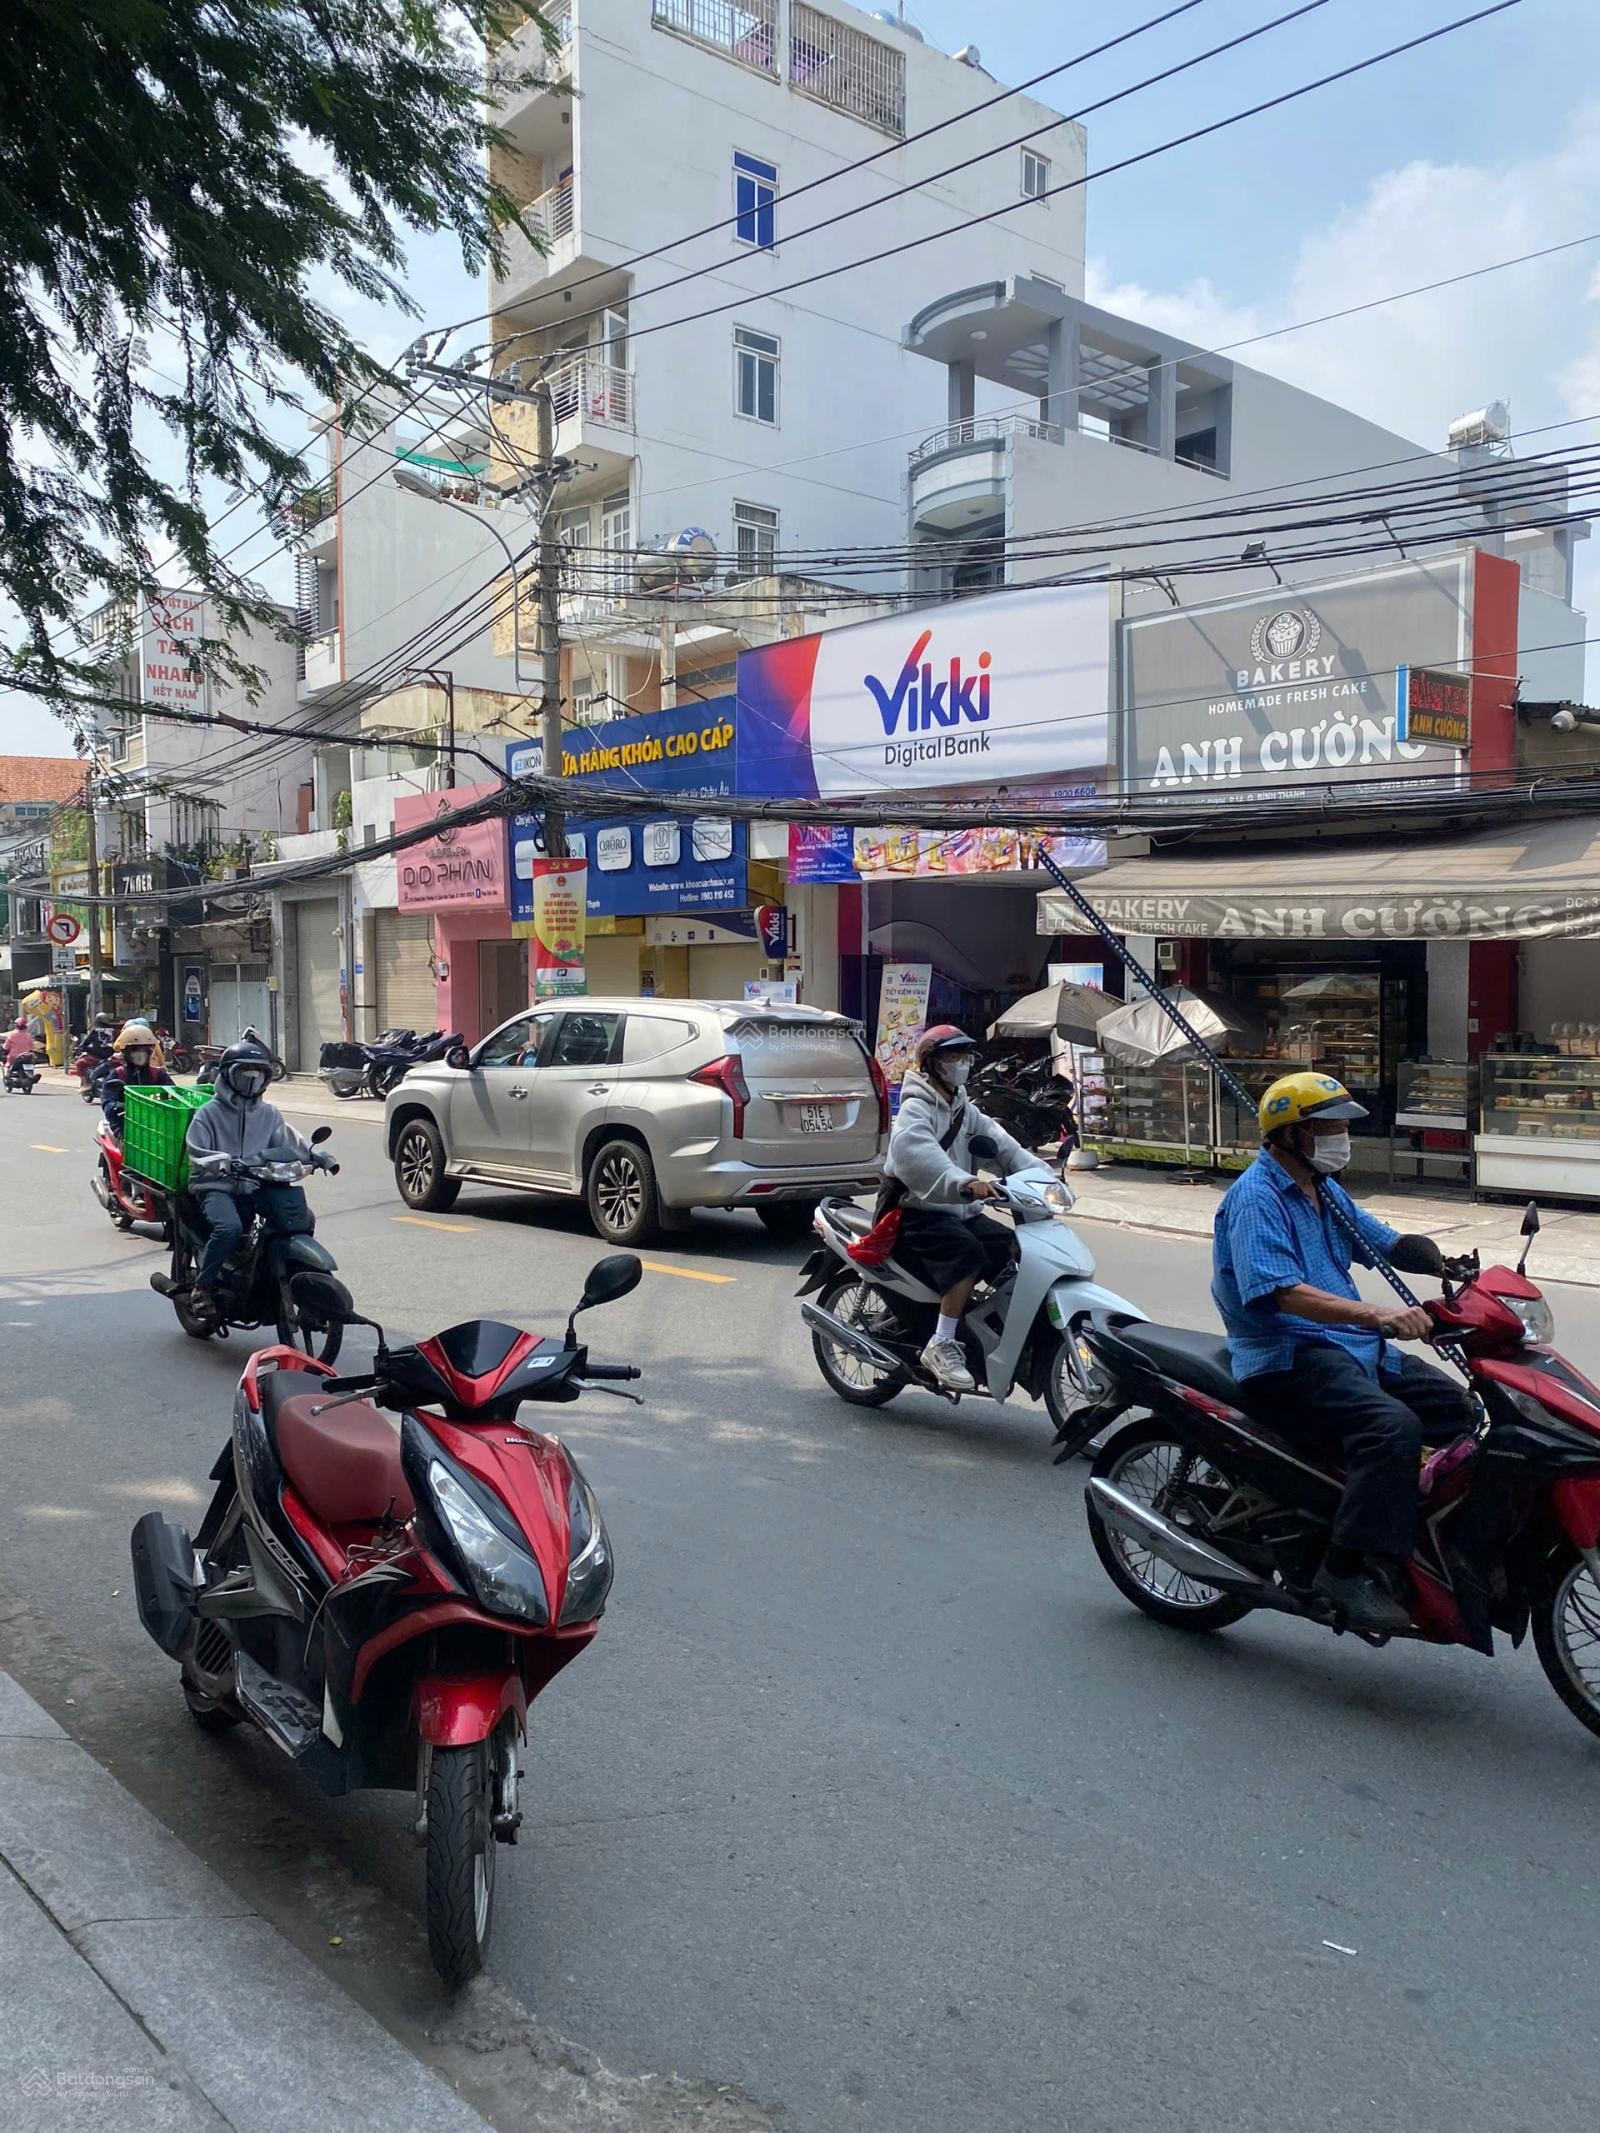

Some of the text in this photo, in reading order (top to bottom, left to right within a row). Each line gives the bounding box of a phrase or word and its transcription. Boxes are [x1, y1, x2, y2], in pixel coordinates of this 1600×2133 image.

[864, 629, 992, 736] Vikki
[1236, 654, 1335, 688] BAKERY
[1208, 681, 1368, 715] HOMEMADE FRESH CAKE
[580, 746, 620, 772] HÀNG
[621, 735, 663, 766] KHÓA
[665, 731, 698, 756] CAO
[701, 716, 734, 752] CẤP
[885, 730, 991, 768] Digital Bank
[1150, 736, 1243, 788] ANH
[1074, 786, 1096, 797] 6608
[1092, 898, 1192, 920] BAKERY
[1214, 897, 1561, 938] ANH CƯỜNG
[764, 911, 780, 946] Vikki
[1178, 923, 1209, 936] CAKE
[807, 1106, 825, 1119] 51E
